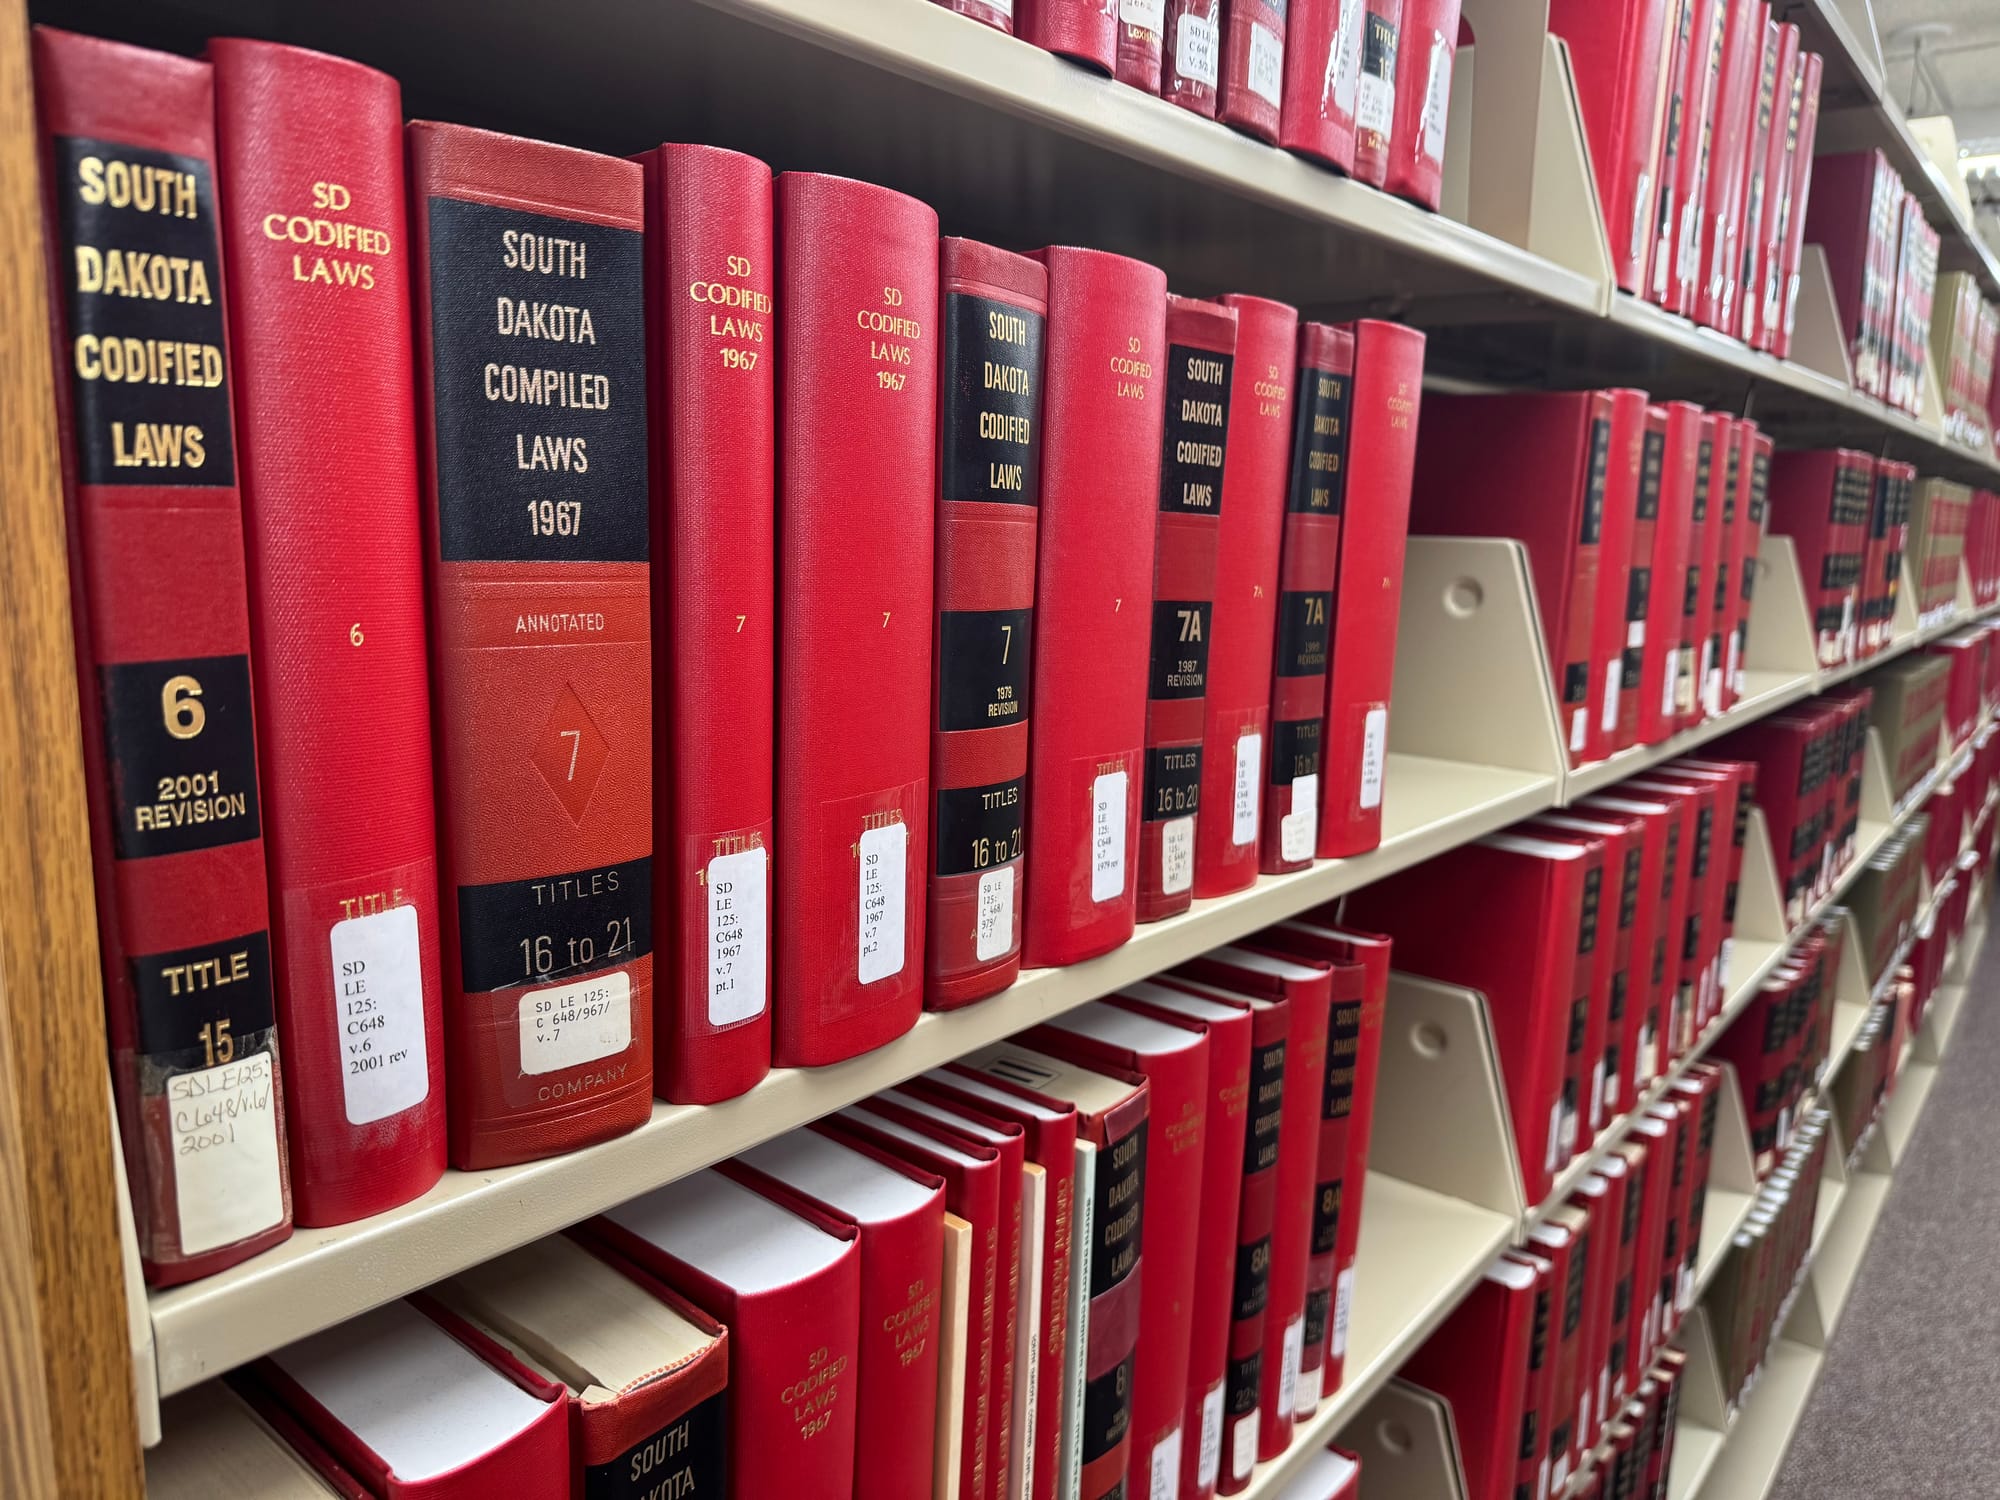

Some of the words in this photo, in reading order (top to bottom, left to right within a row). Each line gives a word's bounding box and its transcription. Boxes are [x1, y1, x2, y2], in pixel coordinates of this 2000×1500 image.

[79, 156, 197, 220] SOUTH
[312, 181, 351, 211] SD
[263, 214, 391, 256] CODIFIED
[503, 230, 586, 280] SOUTH
[727, 256, 751, 277] SD
[75, 245, 212, 305] DAKOTA
[293, 256, 375, 290] LAWS
[689, 281, 772, 315] CODIFIED
[884, 287, 902, 307] SD
[497, 297, 595, 345] DAKOTA
[710, 315, 764, 342] LAWS
[857, 310, 921, 340] CODIFIED
[989, 311, 1027, 347] SOUTH
[871, 341, 911, 366] LAWS
[1128, 336, 1141, 353] SD
[75, 335, 223, 388] CODIFIED
[720, 348, 758, 371] 1967
[1110, 356, 1152, 379] CODIFIED
[1187, 357, 1224, 385] SOUTH
[484, 363, 610, 411] COMPILED
[876, 371, 906, 391] 1967
[984, 362, 1030, 397] DAKOTA
[1118, 381, 1144, 400] LAWS
[1318, 377, 1341, 400] SOUTH
[1181, 399, 1222, 427] DAKOTA
[979, 411, 1031, 445] CODIFIED
[112, 422, 205, 468] LAWS
[516, 434, 588, 474] LAWS
[1177, 440, 1222, 468] CODIFIED
[990, 463, 1022, 491] LAWS
[1183, 482, 1212, 507] LAWS
[527, 500, 581, 536] 1967
[1253, 585, 1263, 598] 7A
[1115, 598, 1122, 612] 7
[1304, 598, 1324, 625] 7A
[515, 613, 605, 633] ANNOTATED
[735, 615, 746, 633] 7
[883, 612, 891, 628] 7
[1177, 610, 1202, 642] 7A
[350, 623, 364, 647] 6
[1001, 625, 1012, 665] 7
[1178, 660, 1197, 673] 1987
[1167, 673, 1203, 687] REVISION
[997, 686, 1012, 700] 1979
[161, 675, 206, 739] 6
[988, 700, 1018, 717] REVISION
[560, 730, 581, 781] 7
[1165, 753, 1196, 770] TITLES
[158, 770, 220, 800] 2001
[982, 787, 1018, 811] TITLES
[1158, 787, 1173, 812] 16
[1175, 789, 1185, 810] to
[1186, 784, 1198, 807] 20
[135, 793, 246, 832] REVISION
[866, 854, 879, 866] SD
[971, 837, 990, 869] 16
[995, 840, 1007, 863] to
[1011, 826, 1021, 857] 21
[866, 868, 878, 881] LE
[531, 870, 620, 906] TITLES
[716, 882, 733, 895] SD
[866, 883, 882, 896] 125:
[716, 899, 732, 911] LE
[865, 896, 885, 910] C648
[716, 914, 739, 928] 125:
[865, 910, 884, 925] 1967
[716, 929, 743, 943] C648
[865, 927, 877, 939] v.7
[519, 935, 553, 976] 16
[567, 936, 594, 966] to
[606, 916, 632, 958] 21
[716, 945, 741, 960] 1967
[863, 941, 878, 957] pt.2
[161, 951, 250, 996] TITLE
[342, 960, 366, 977] SD
[716, 963, 732, 975] v.7
[344, 979, 366, 996] LE
[716, 979, 735, 995] pt.1
[346, 999, 377, 1016] 125:
[535, 1001, 552, 1013] SD
[560, 996, 574, 1009] LE
[583, 988, 610, 1003] 125:
[347, 1016, 385, 1036] C648
[536, 1017, 543, 1028] C
[552, 1001, 610, 1026] 648/967/
[199, 1018, 234, 1067] 15
[348, 1038, 372, 1054] v.6
[536, 1029, 561, 1042] v.7
[350, 1055, 384, 1074] 2001
[388, 1047, 408, 1063] rev
[537, 1063, 629, 1101] COMPANY
[180, 1123, 235, 1155] 2001
[907, 1280, 924, 1300] SD
[895, 1314, 929, 1348] LAWS
[808, 1347, 828, 1370] SD
[780, 1354, 849, 1405] CODIFIED
[794, 1388, 839, 1422] LAWS
[801, 1413, 831, 1441] 1967
[630, 1420, 689, 1482] SOUTH
